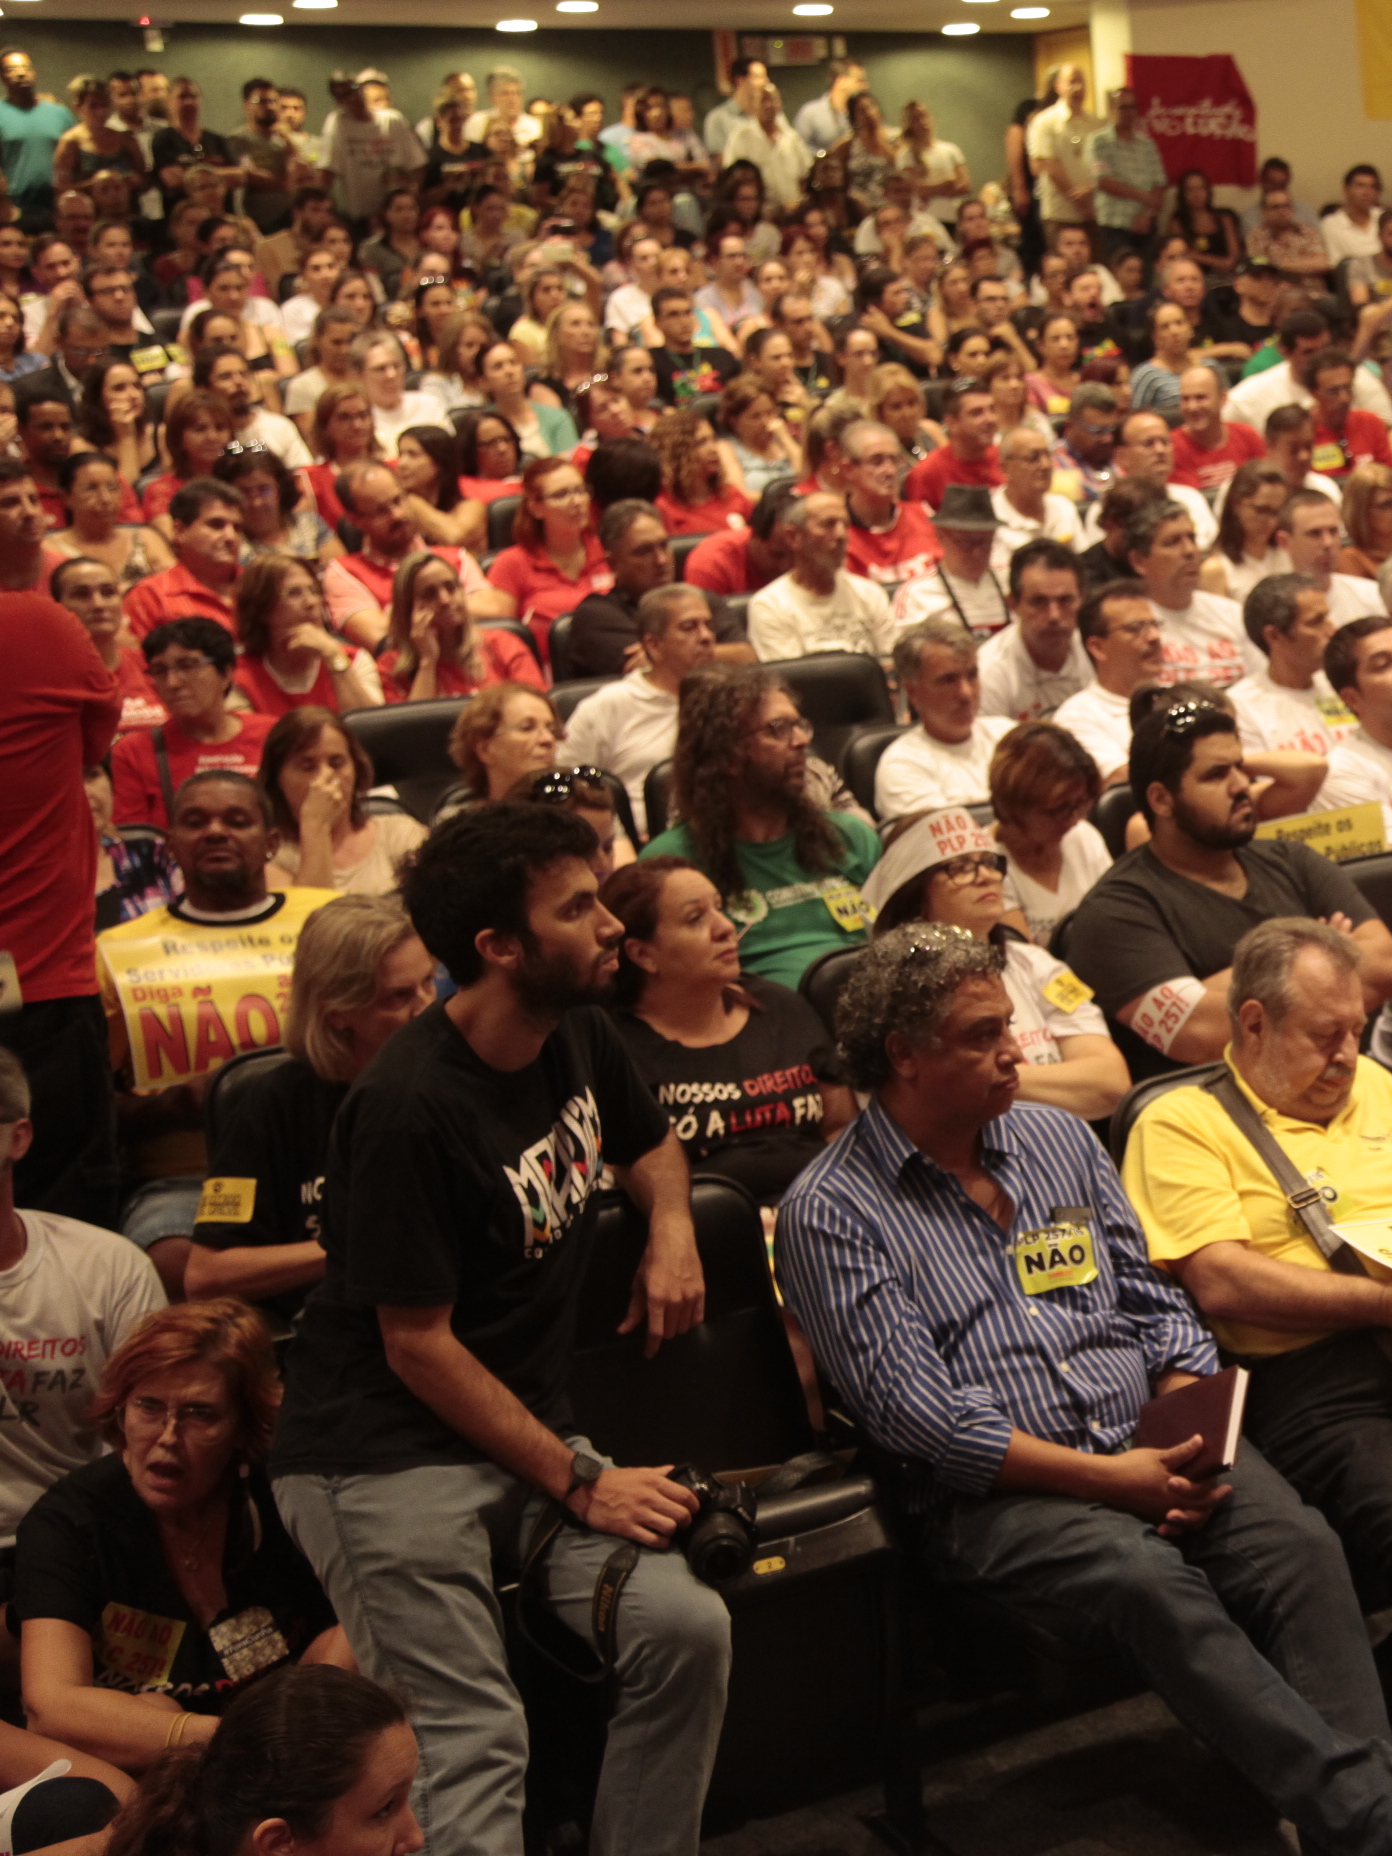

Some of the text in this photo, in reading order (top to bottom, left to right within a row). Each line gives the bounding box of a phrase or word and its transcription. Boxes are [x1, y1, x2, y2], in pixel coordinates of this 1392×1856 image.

[928, 813, 968, 839] NÃO
[936, 834, 967, 856] PLP
[162, 933, 271, 956] Respeite
[131, 976, 184, 1004] Diga
[138, 984, 282, 1079] NÃO
[658, 1063, 819, 1106] NOSSOS DIREITO
[705, 1108, 726, 1139] A
[730, 1100, 792, 1133] LUTA
[1023, 1242, 1086, 1276] NÃO
[31, 1367, 87, 1395] FAZ
[598, 1583, 614, 1633] Nikon
